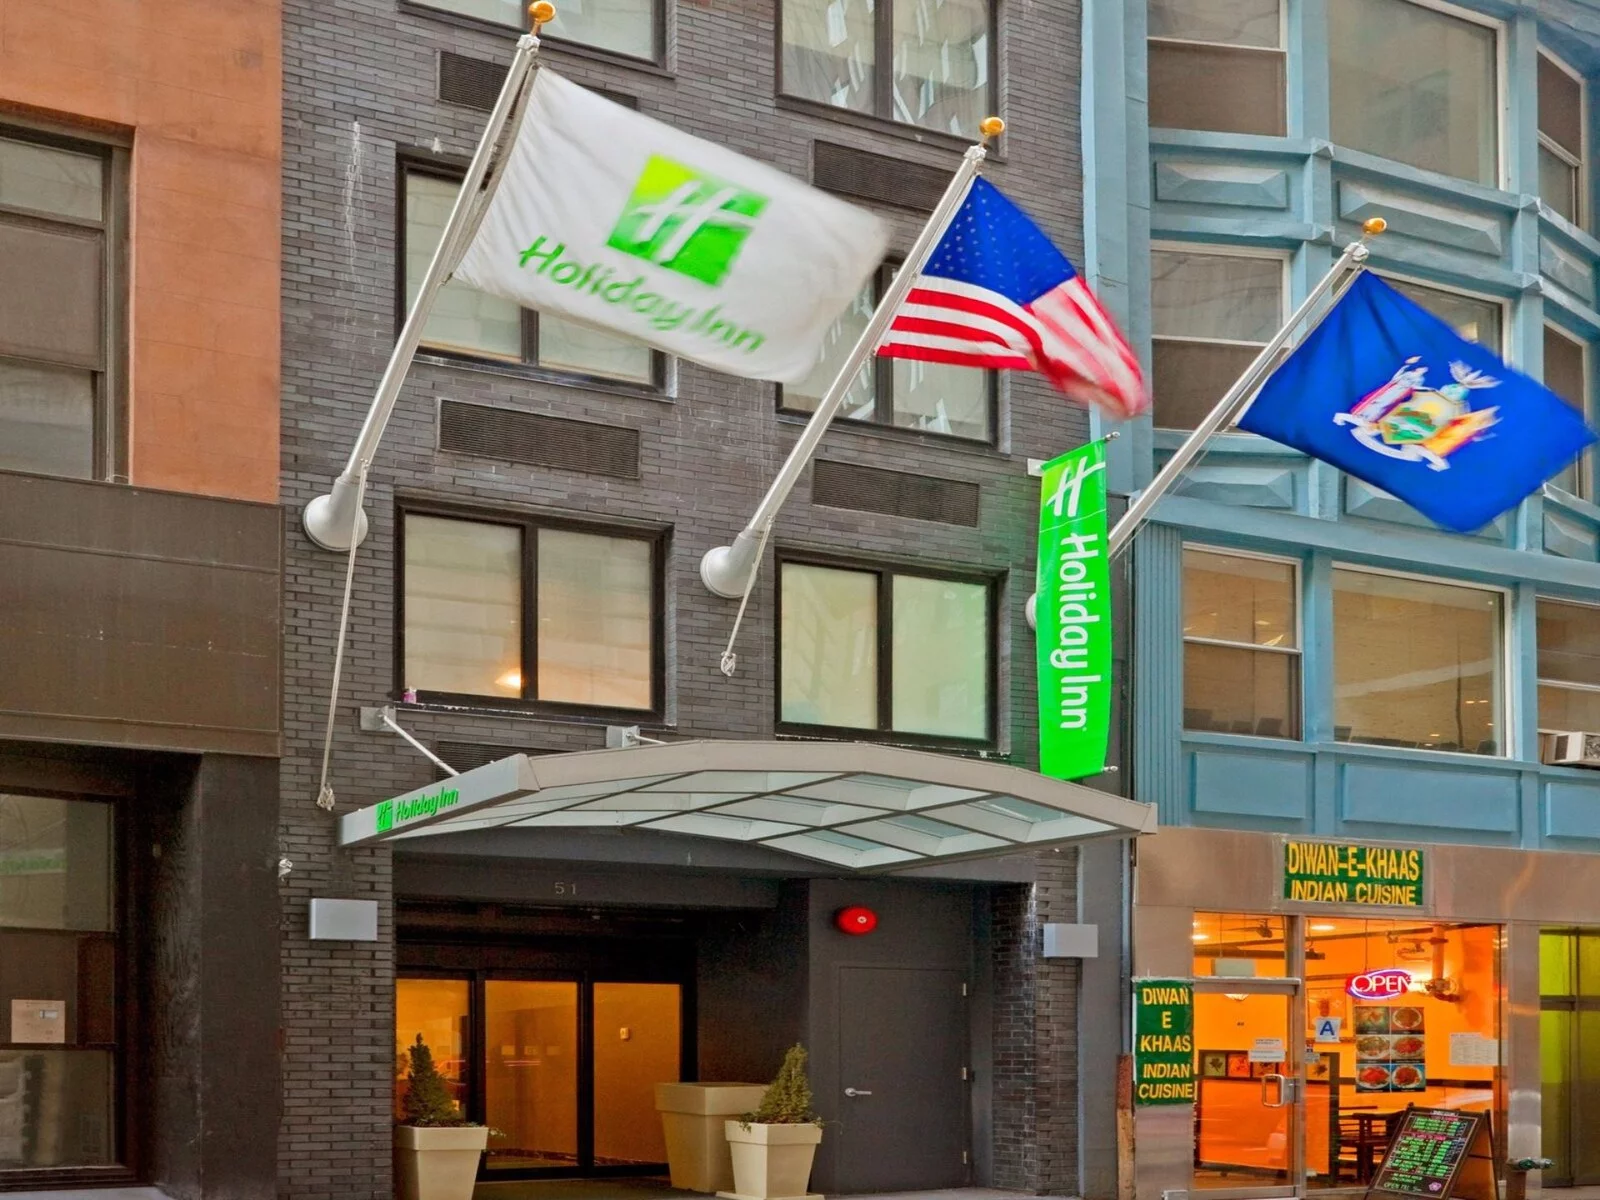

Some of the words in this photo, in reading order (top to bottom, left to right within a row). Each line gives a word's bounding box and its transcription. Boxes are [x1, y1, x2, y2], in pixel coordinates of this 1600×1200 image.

[519, 235, 696, 331] Holiday
[689, 303, 767, 354] Inn
[1049, 532, 1100, 669] Holiday
[1060, 674, 1101, 729] Inn
[396, 793, 439, 822] Holiday
[439, 786, 459, 809] Inn
[1288, 841, 1419, 881] DIWAN-E-KHAAS
[1291, 879, 1348, 902] INDIAN
[1355, 882, 1417, 906] CUISINE
[1352, 974, 1411, 993] OPEN
[1142, 987, 1189, 1006] DIWAN
[1161, 1011, 1172, 1029] E
[1319, 1020, 1335, 1036] A
[1140, 1034, 1191, 1053] KHAAS
[1143, 1062, 1190, 1079] INDIAN
[1138, 1082, 1194, 1099] CUISINE
